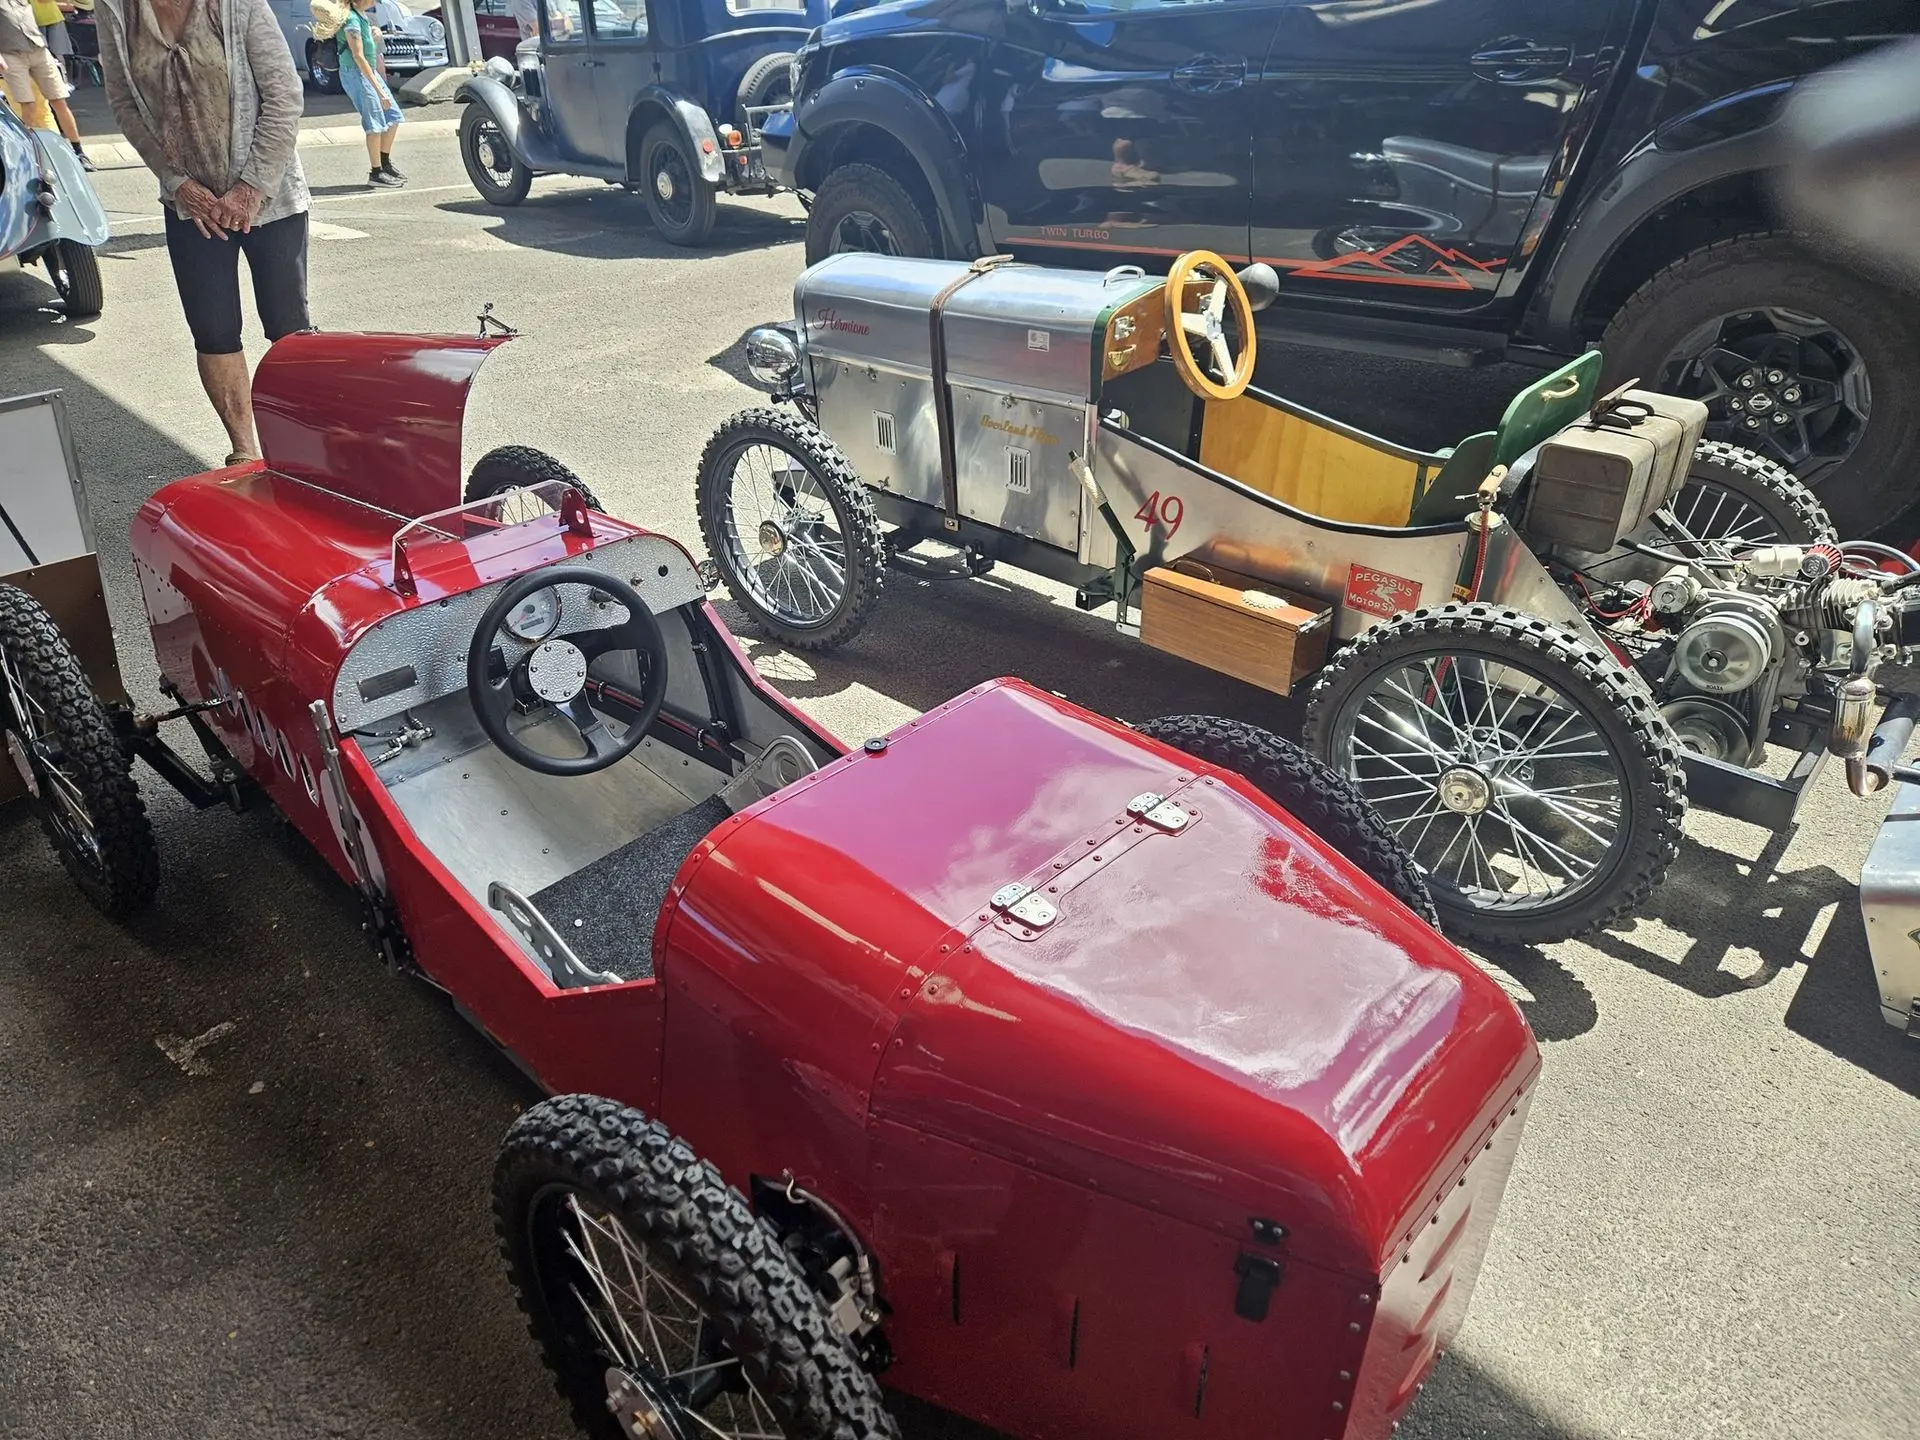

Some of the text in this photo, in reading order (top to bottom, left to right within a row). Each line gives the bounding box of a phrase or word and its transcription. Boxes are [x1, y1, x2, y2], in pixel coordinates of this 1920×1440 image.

[1040, 225, 1110, 240] TWIN TURBO
[812, 308, 870, 336] Hermione
[1134, 490, 1183, 540] 49
[1355, 573, 1413, 597] PEGASUS
